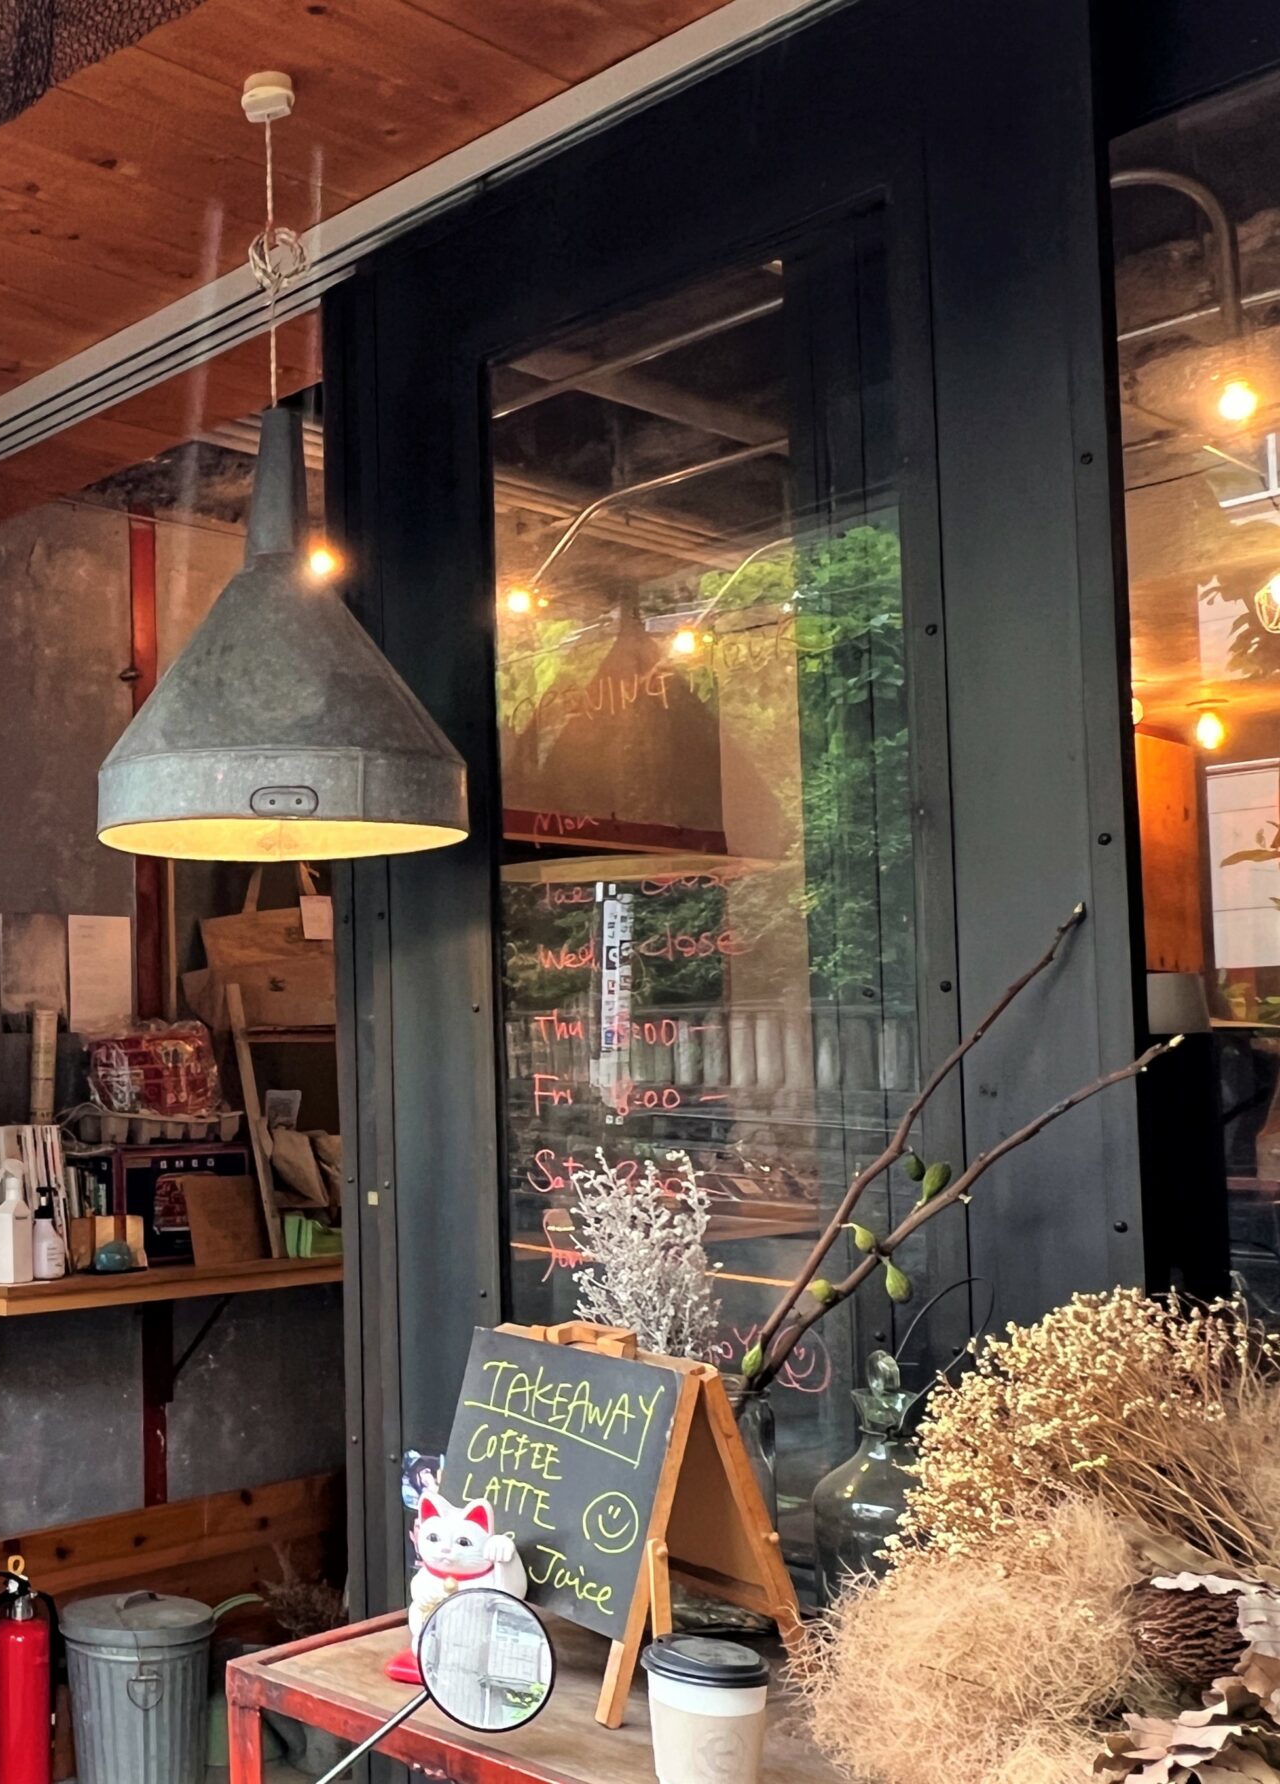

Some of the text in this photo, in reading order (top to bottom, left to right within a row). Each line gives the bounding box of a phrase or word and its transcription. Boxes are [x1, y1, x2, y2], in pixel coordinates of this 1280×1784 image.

[534, 811, 599, 848] Mon
[534, 1009, 585, 1043] Thu
[483, 1361, 666, 1469] TAKEAWAY
[462, 1473, 557, 1531] LATTE
